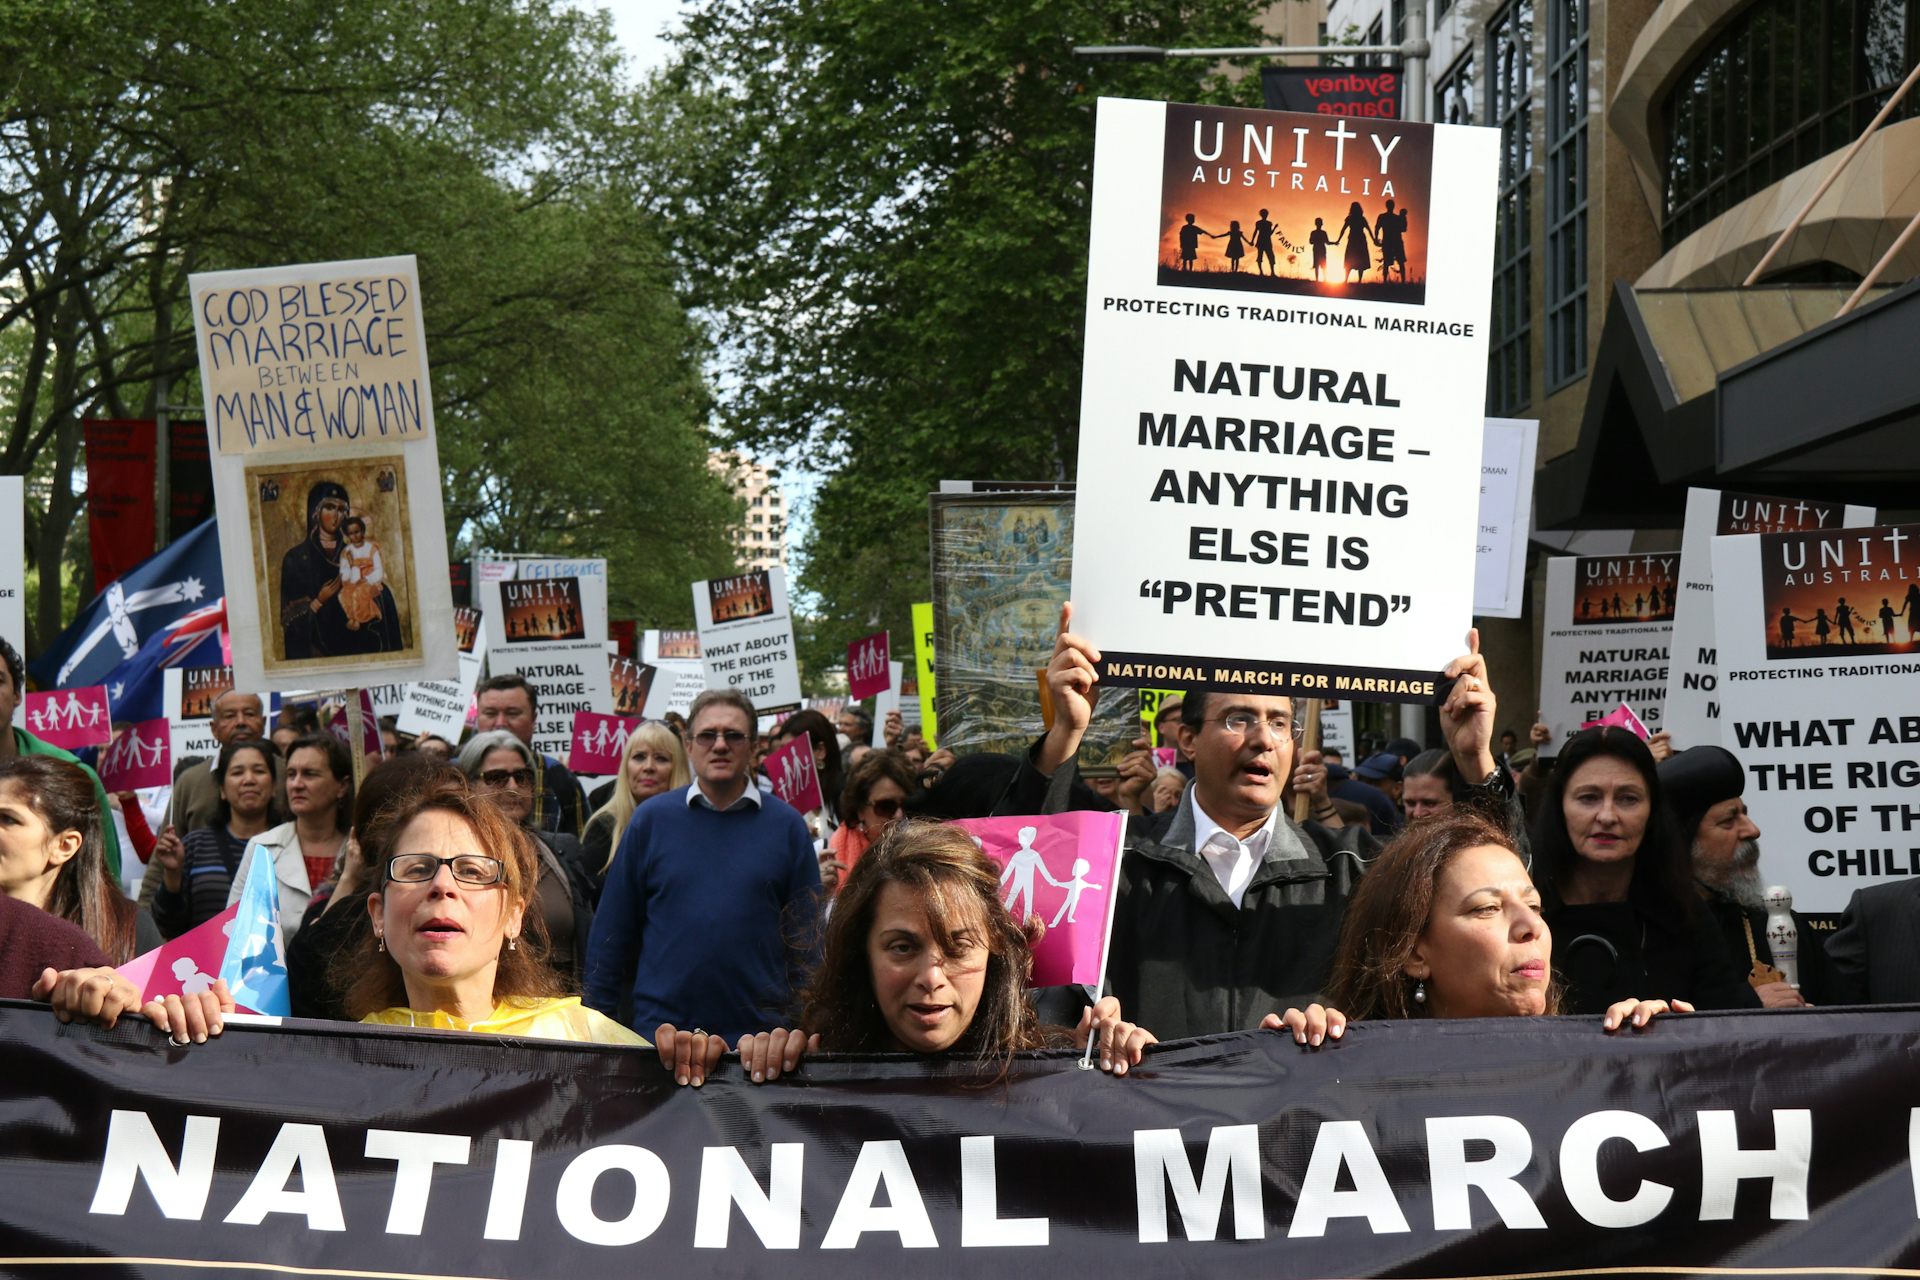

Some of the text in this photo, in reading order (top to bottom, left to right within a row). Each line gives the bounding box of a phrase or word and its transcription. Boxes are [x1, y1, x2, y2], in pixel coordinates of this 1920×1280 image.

[1193, 119, 1401, 175] UNITY
[1192, 165, 1395, 197] AUSTRALIA
[204, 278, 407, 327] GOD BLESSED
[1103, 296, 1474, 338] PROTECTING TRADITIONAL MARRIAGE
[210, 316, 407, 370] MARRIAGE
[258, 362, 359, 389] BETWEEN
[1173, 358, 1401, 408] NATURAL
[216, 391, 291, 451] MAN
[317, 379, 422, 440] WOMAN
[1138, 411, 1395, 462] MARRIAGE
[1481, 466, 1508, 475] OMAN
[1150, 468, 1409, 518] ANYTHING
[1188, 526, 1369, 571] ELSE IS
[1782, 527, 1920, 571] UNIT
[1586, 574, 1672, 586] AUSTRALIA
[455, 607, 479, 620] ITY
[1139, 578, 1412, 627] “PRETEND”
[662, 631, 697, 640] UNIT
[1551, 629, 1603, 637] PROTECTING
[1605, 626, 1660, 635] TRADITIONAL
[705, 633, 789, 659] WHAT ABOUT
[1579, 647, 1670, 664] NATURAL
[516, 663, 584, 678] NATURAL
[609, 658, 646, 680] ITY
[710, 650, 788, 673] THE RIGHTS
[188, 665, 233, 684] UNIT
[728, 668, 775, 685] OF THE
[1107, 661, 1435, 696] NATIONAL MARCH FOR MARRIAGE
[1565, 666, 1669, 684] MARRIAGE
[1729, 667, 1824, 681] PROTECTING
[418, 681, 459, 697] MARRIAGE
[534, 683, 585, 697] RRIAGE
[740, 684, 776, 698] HILD?
[410, 692, 465, 713] NOTHING CAN
[537, 701, 592, 715] YTHING
[415, 707, 442, 721] MATCH
[1641, 707, 1660, 721] IS
[1733, 718, 1855, 748] WHAT
[186, 739, 221, 750] NATU
[1749, 763, 1833, 791] THE
[1804, 805, 1858, 833] OF
[88, 1109, 1050, 1250] NATIONAL
[1133, 1107, 1812, 1245] MARCH
